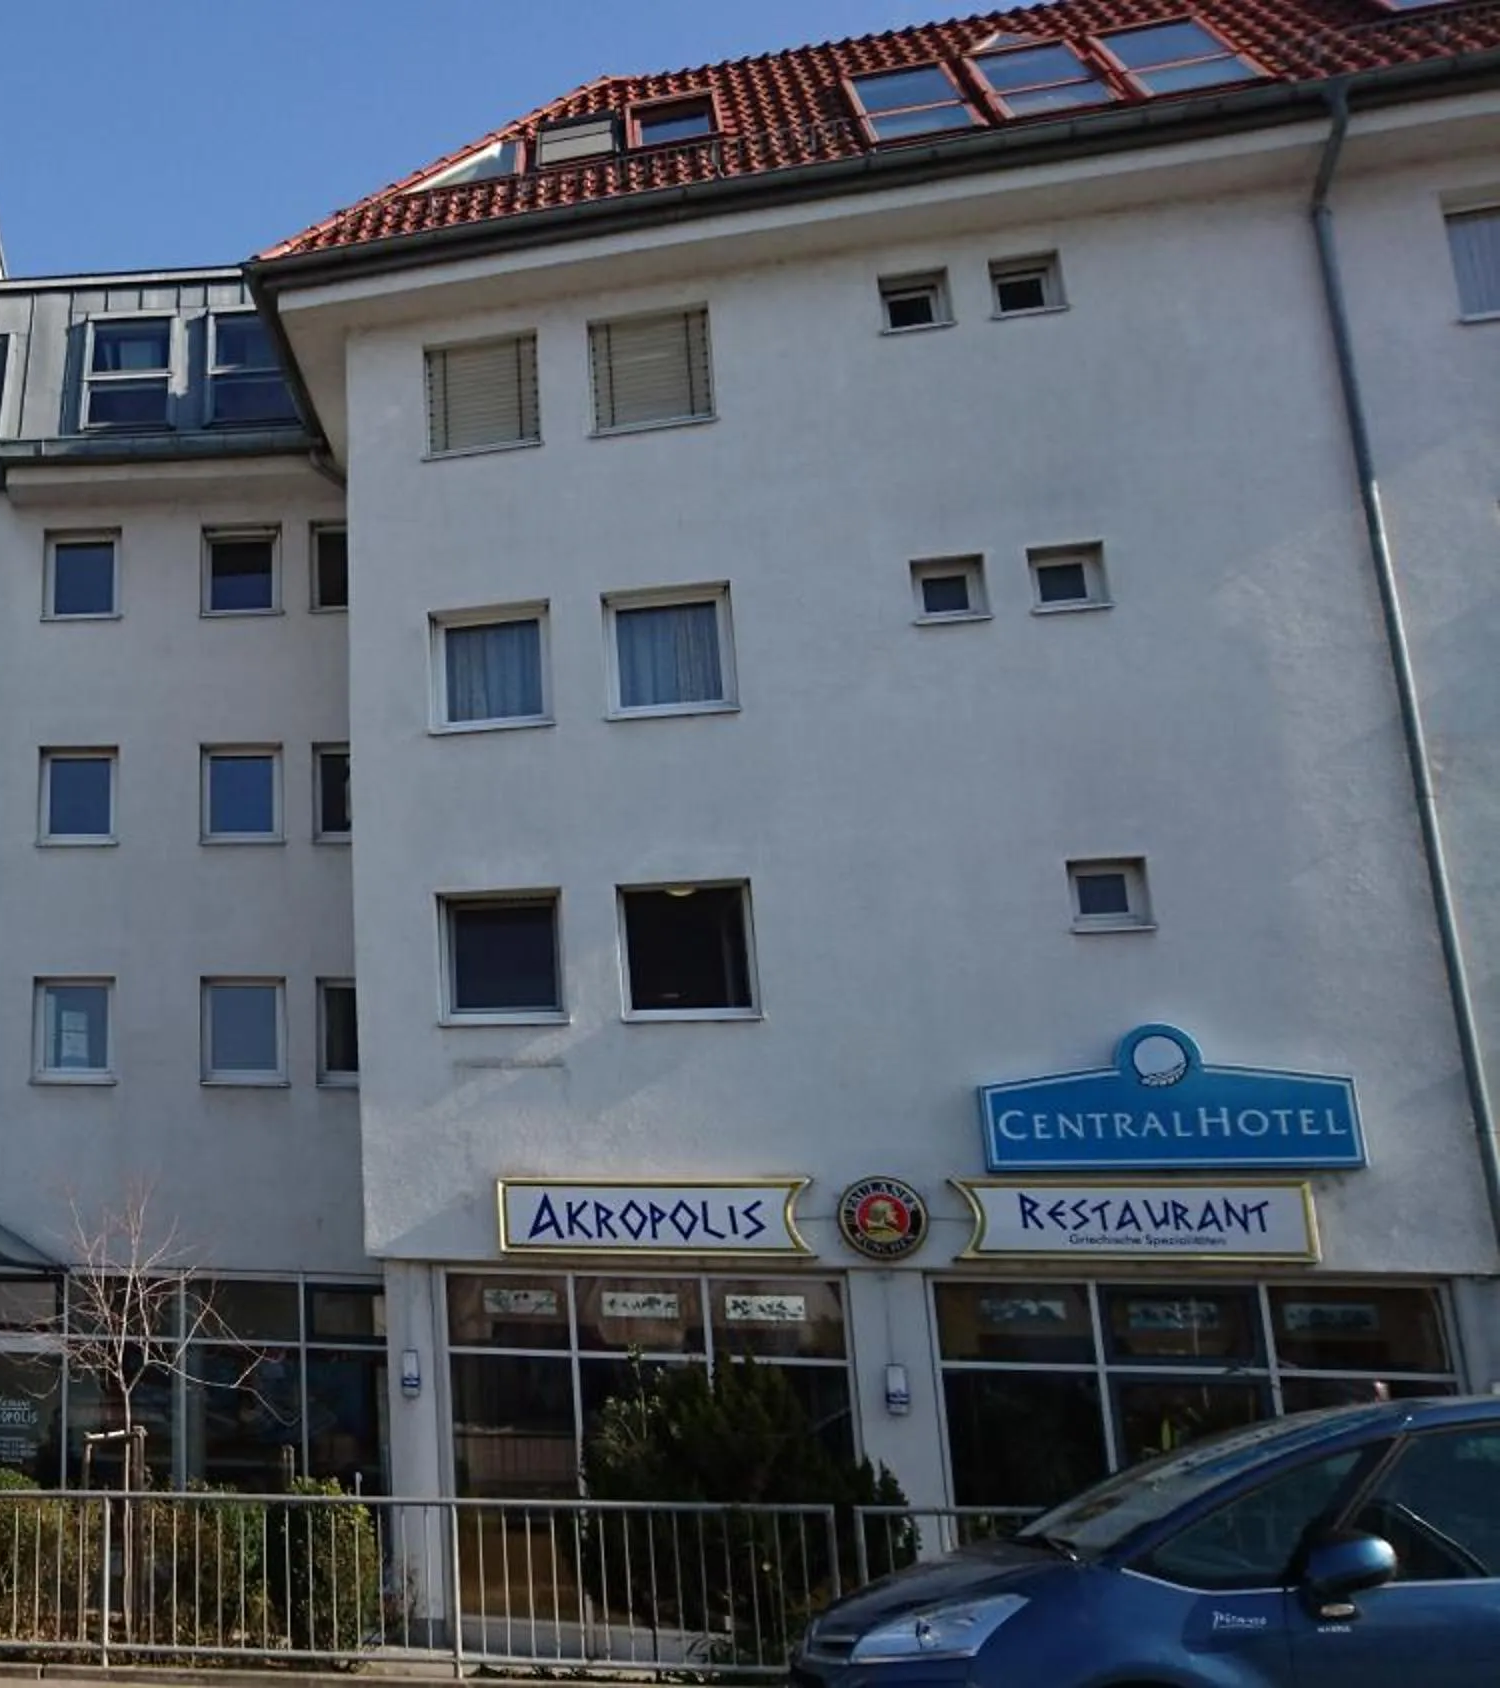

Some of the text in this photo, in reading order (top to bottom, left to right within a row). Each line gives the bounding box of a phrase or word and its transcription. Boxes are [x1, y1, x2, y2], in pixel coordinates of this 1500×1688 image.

[527, 1192, 768, 1241] AKROPOLIS
[1017, 1191, 1270, 1234] RESTAURANT
[1068, 1233, 1142, 1246] Griechische
